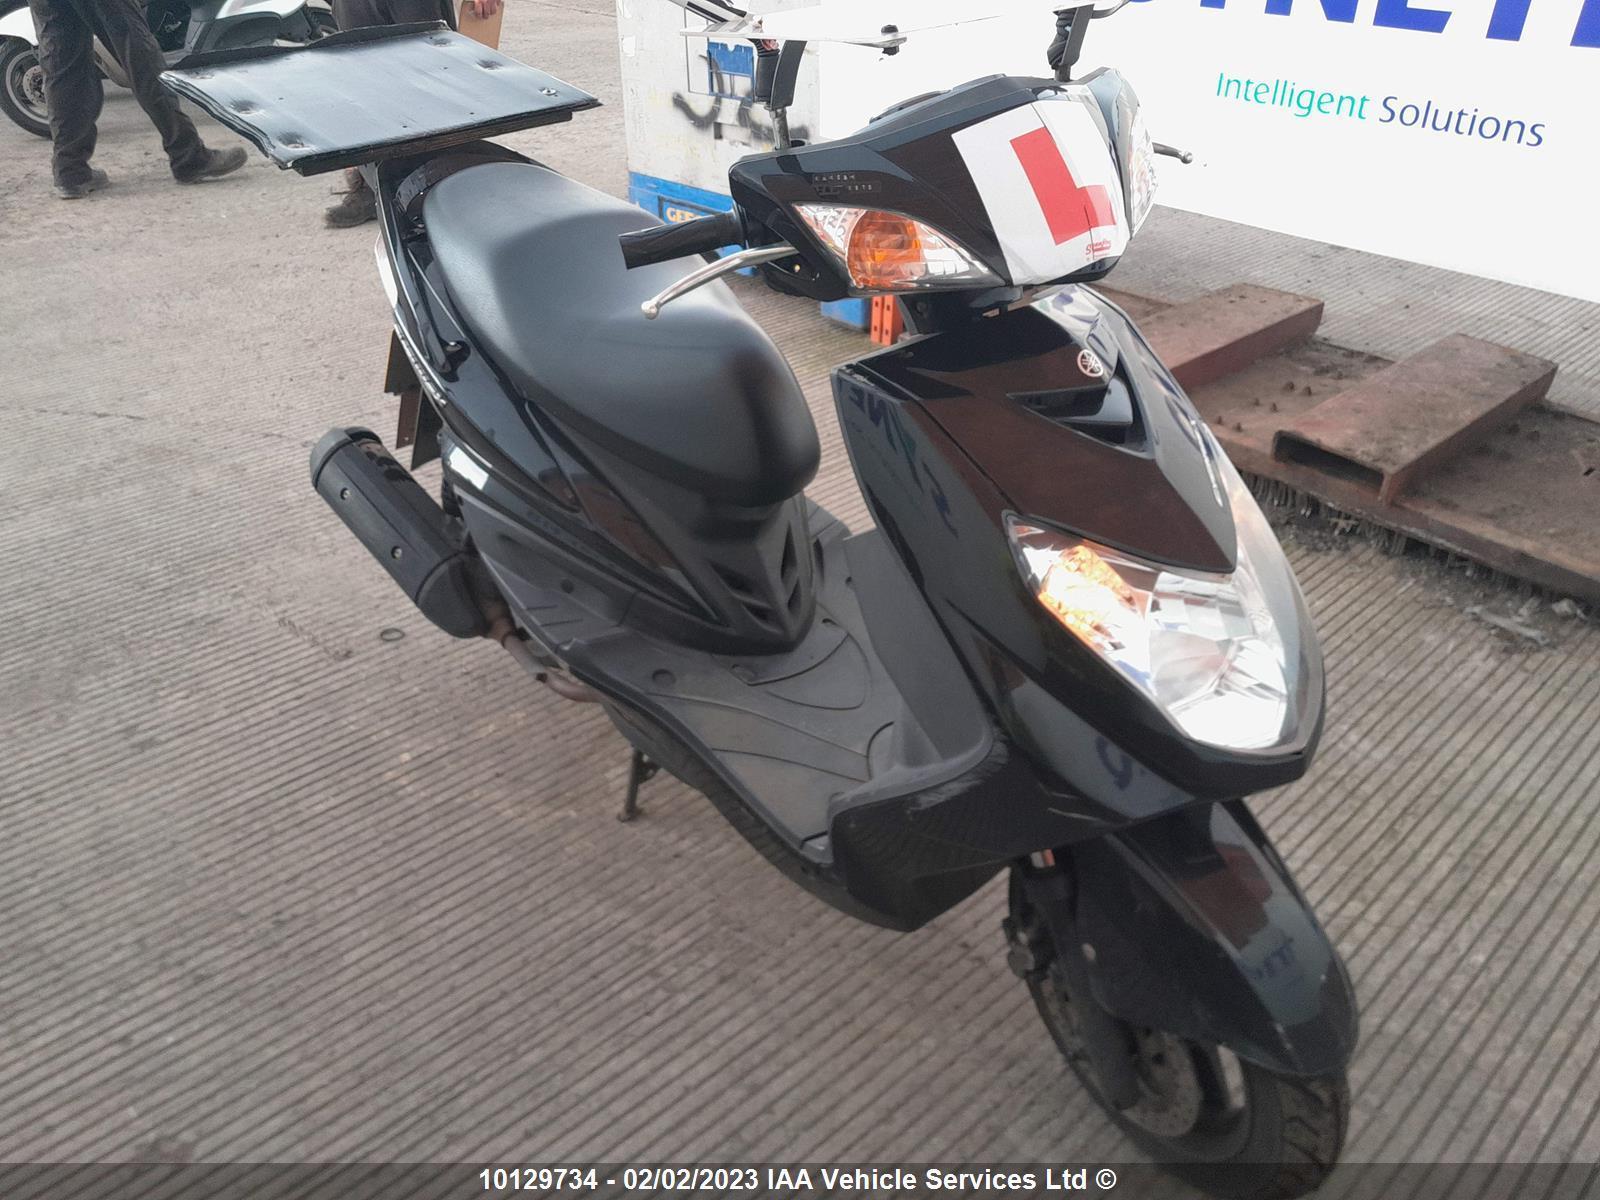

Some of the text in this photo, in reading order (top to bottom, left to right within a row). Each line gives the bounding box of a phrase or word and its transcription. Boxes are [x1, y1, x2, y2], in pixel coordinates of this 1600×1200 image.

[1216, 71, 1546, 148] Intelligent Solutions
[1010, 125, 1117, 247] L
